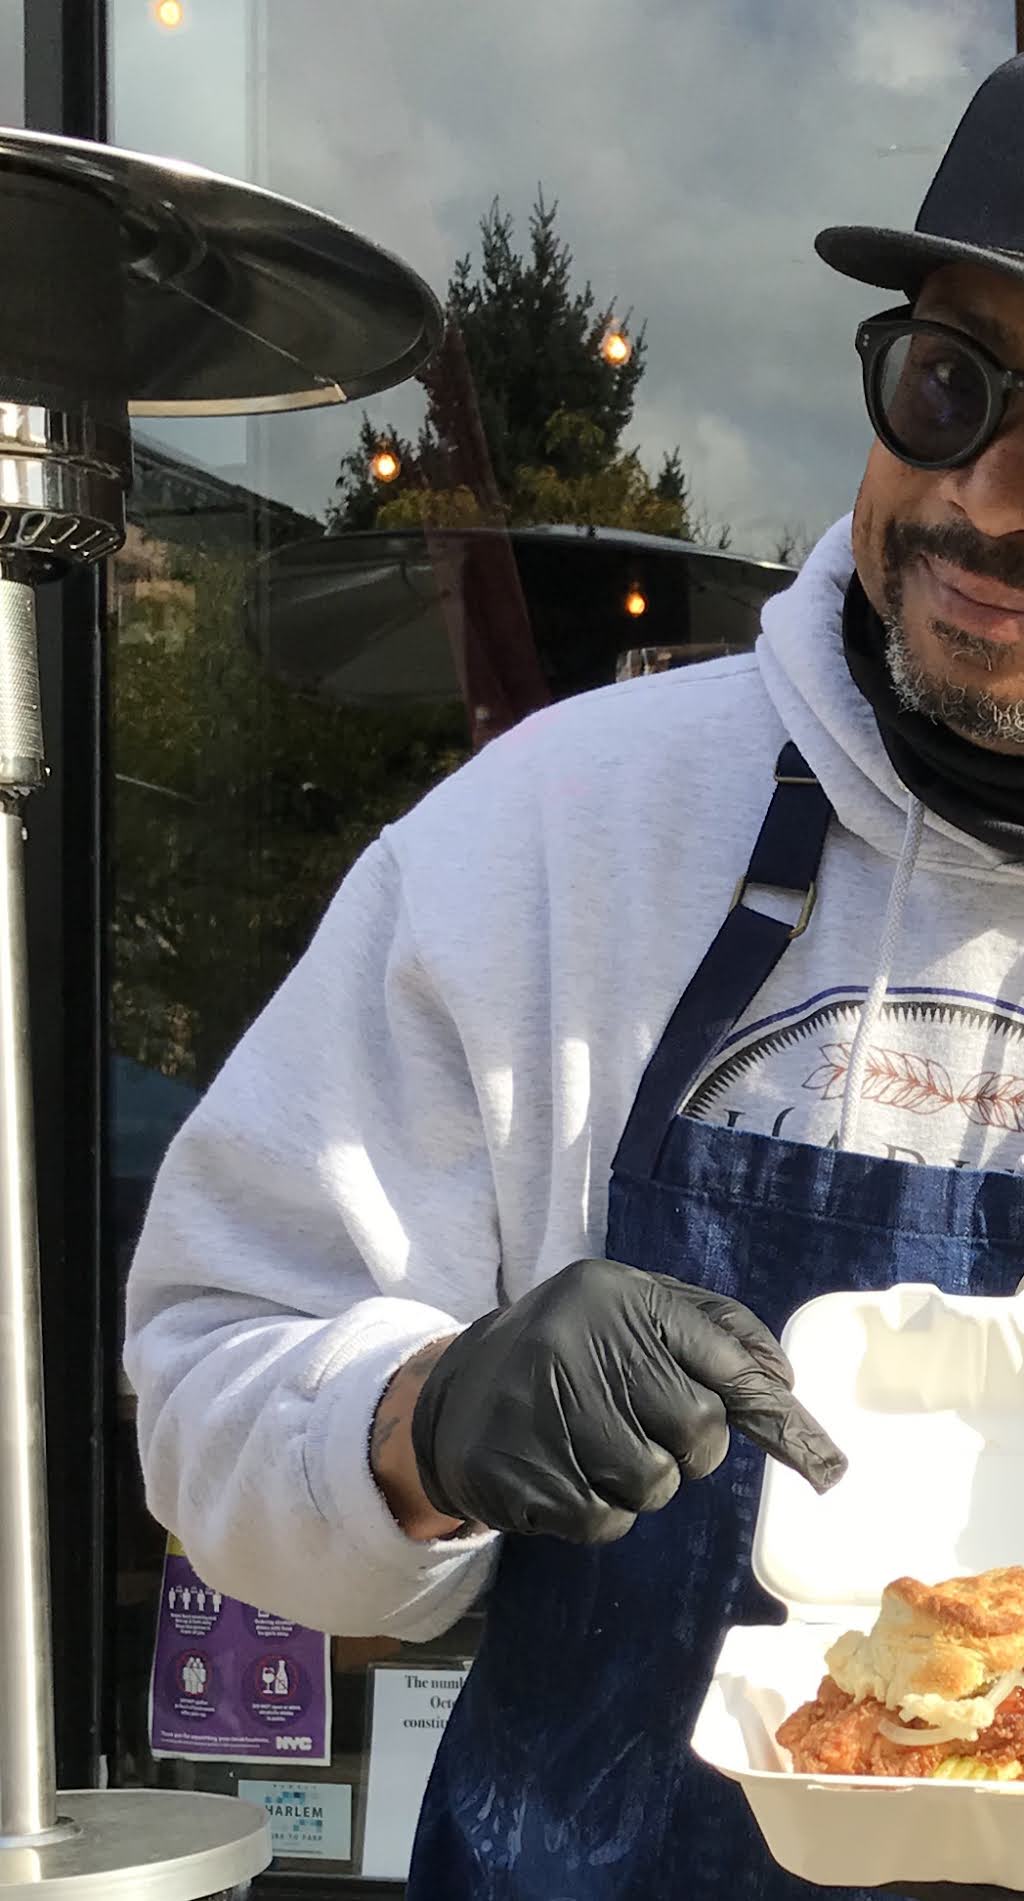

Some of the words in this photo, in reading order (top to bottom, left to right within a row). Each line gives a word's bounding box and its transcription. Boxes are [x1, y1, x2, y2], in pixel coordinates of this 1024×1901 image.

[404, 1675, 429, 1689] The
[403, 1716, 448, 1729] constit
[275, 1735, 313, 1751] NYC
[265, 1804, 323, 1818] HARLEM
